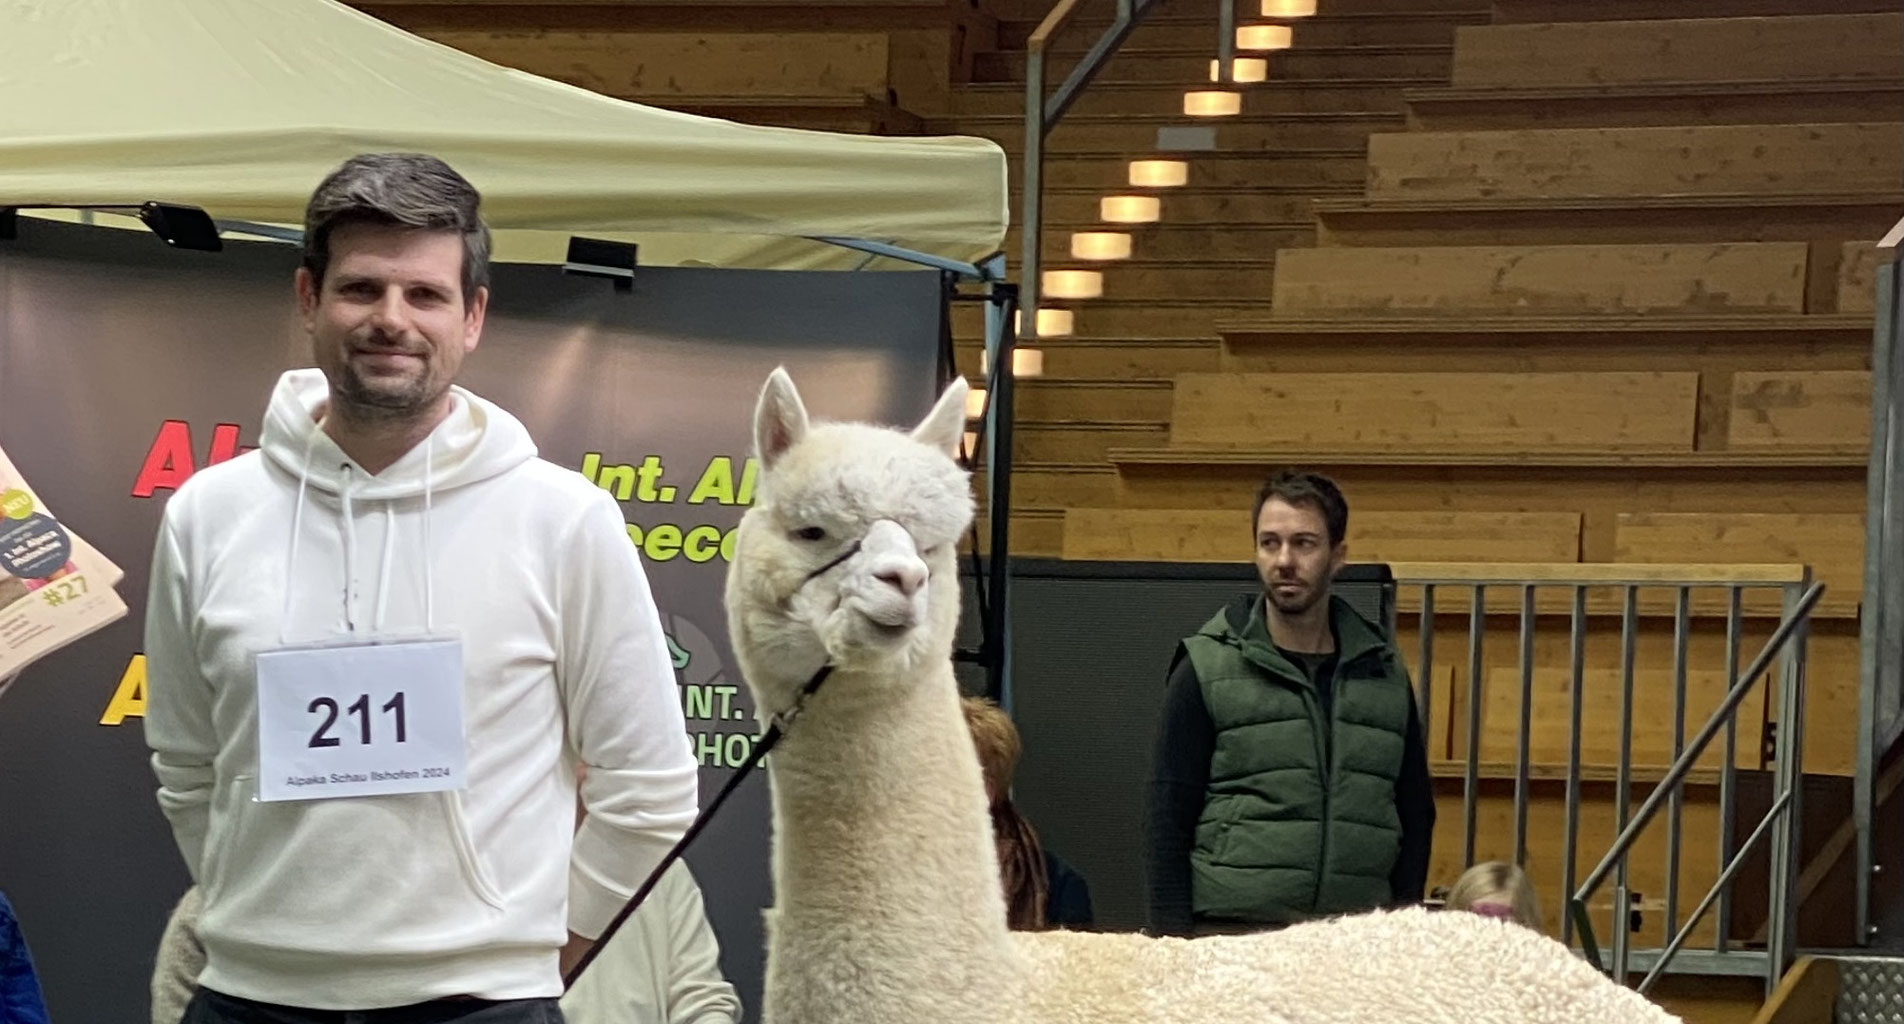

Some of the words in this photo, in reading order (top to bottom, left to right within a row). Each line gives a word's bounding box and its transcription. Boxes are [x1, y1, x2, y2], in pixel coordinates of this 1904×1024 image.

[131, 420, 261, 497] Al
[581, 452, 677, 502] Int.
[43, 575, 88, 607] #27
[307, 691, 407, 748] 211
[678, 684, 743, 720] NT.
[285, 775, 327, 787] Alpaka
[330, 773, 368, 784] Schau
[422, 767, 451, 779] 2024
